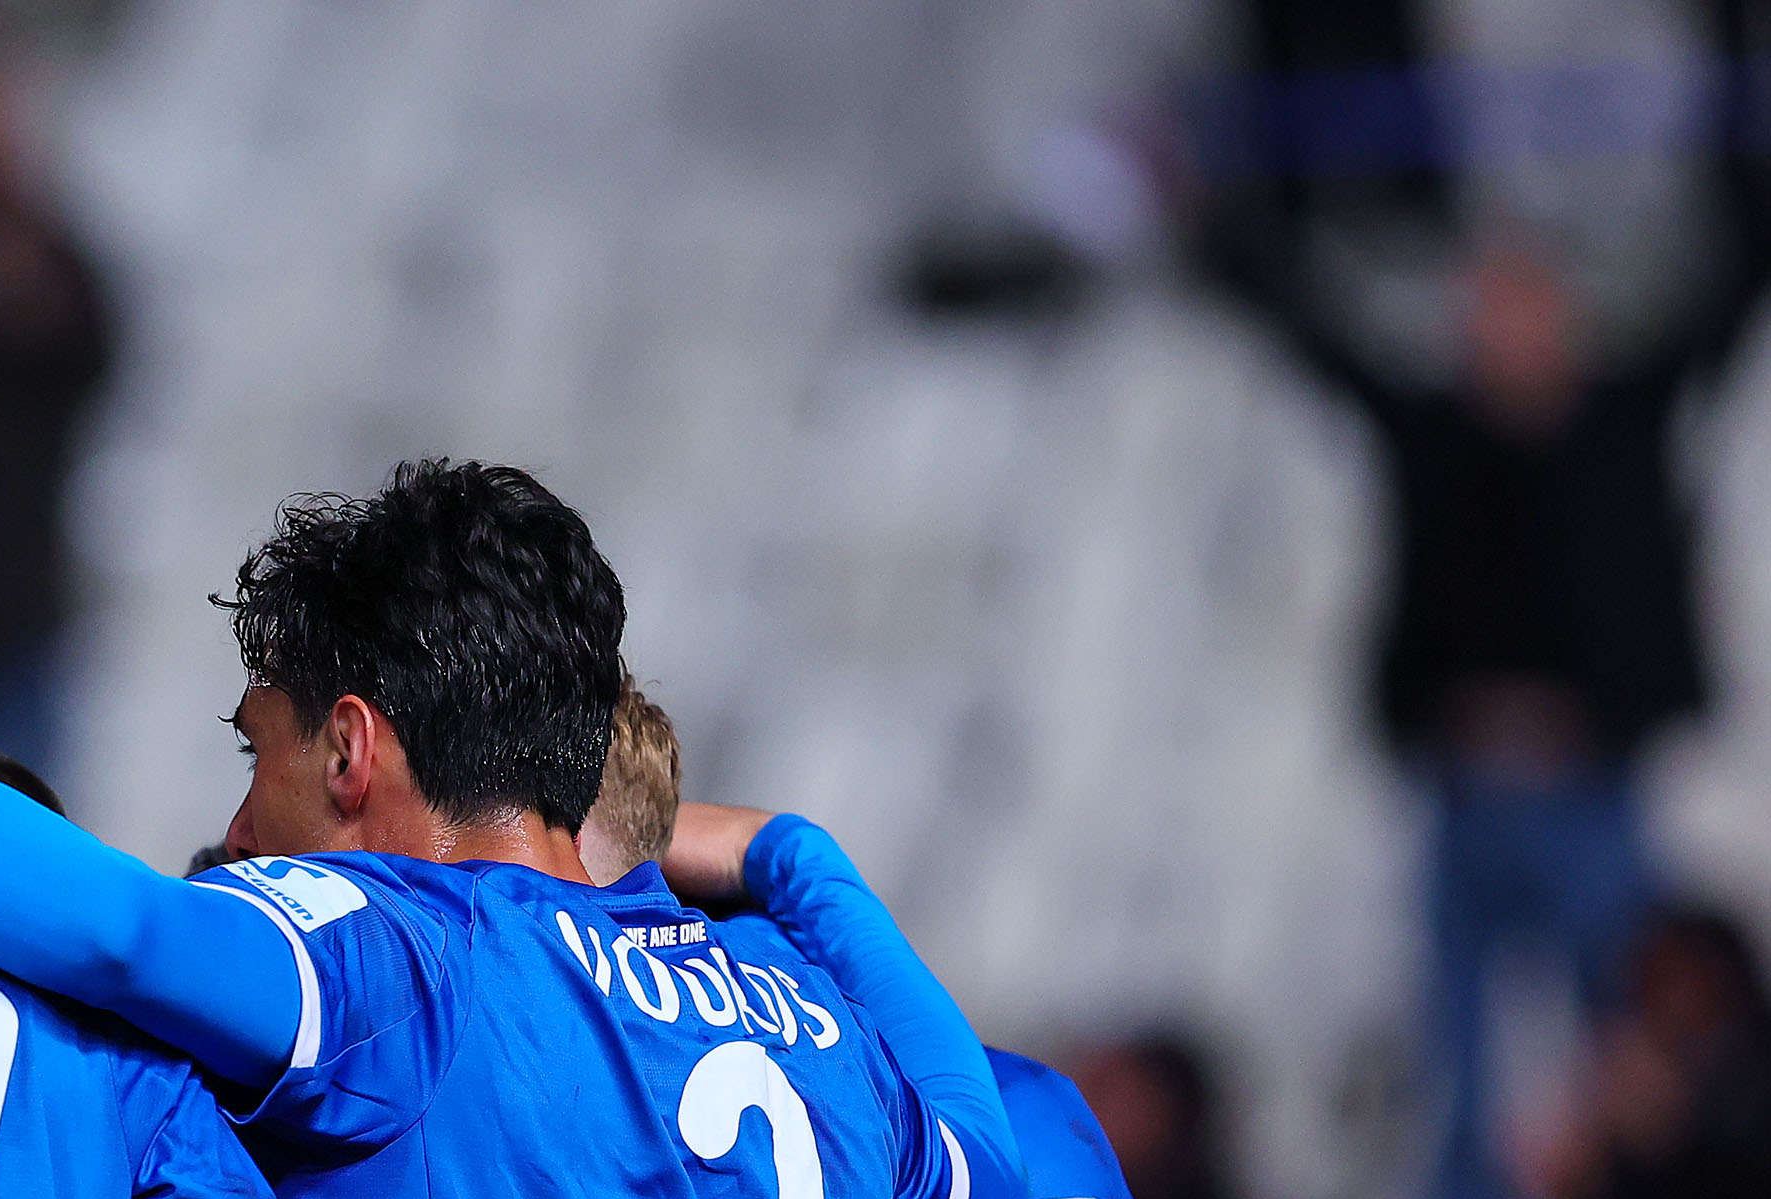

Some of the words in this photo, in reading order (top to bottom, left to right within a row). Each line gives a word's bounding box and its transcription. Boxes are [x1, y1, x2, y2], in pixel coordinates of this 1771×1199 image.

[236, 864, 315, 922] ximan
[649, 925, 678, 948] ARE
[679, 920, 708, 945] ONE
